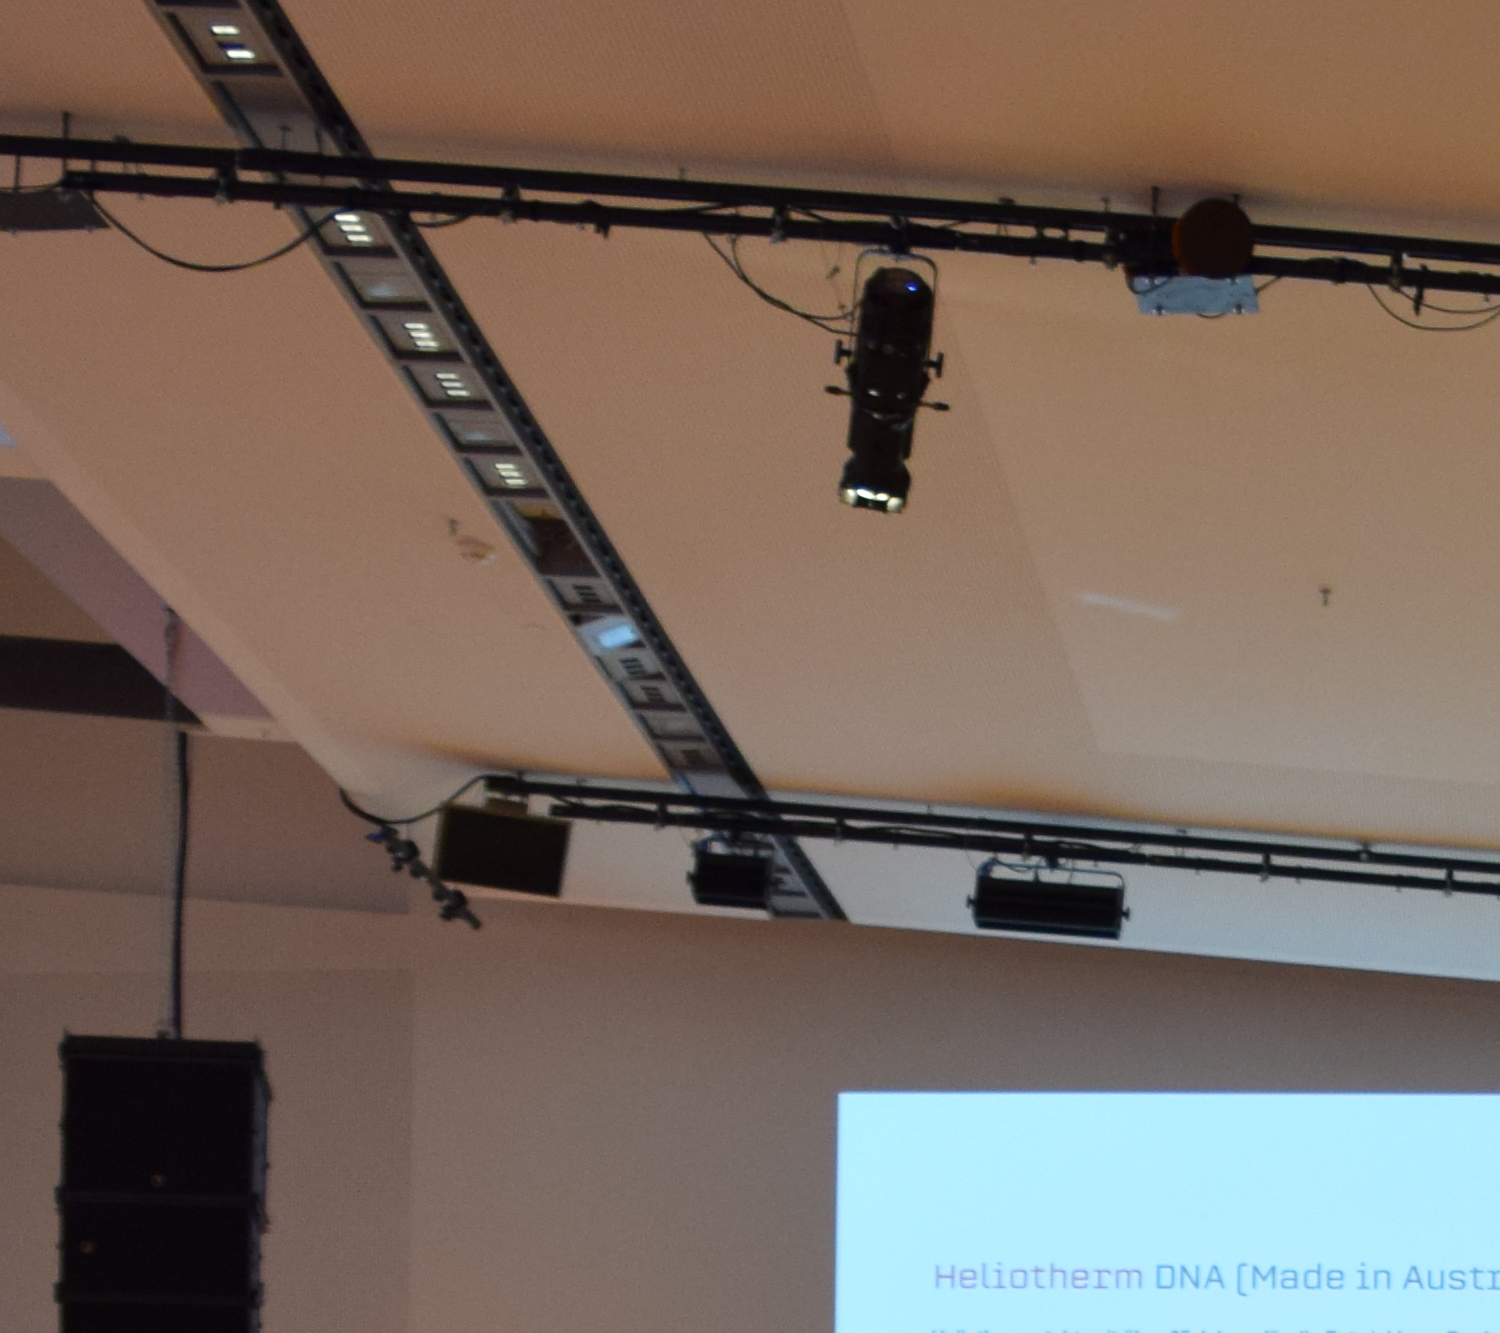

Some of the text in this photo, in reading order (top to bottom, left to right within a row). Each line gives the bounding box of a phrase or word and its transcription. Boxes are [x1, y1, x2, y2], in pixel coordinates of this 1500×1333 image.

[935, 1261, 1143, 1290] Heliotherm
[1155, 1263, 1227, 1290] DNA
[1356, 1261, 1392, 1291] in
